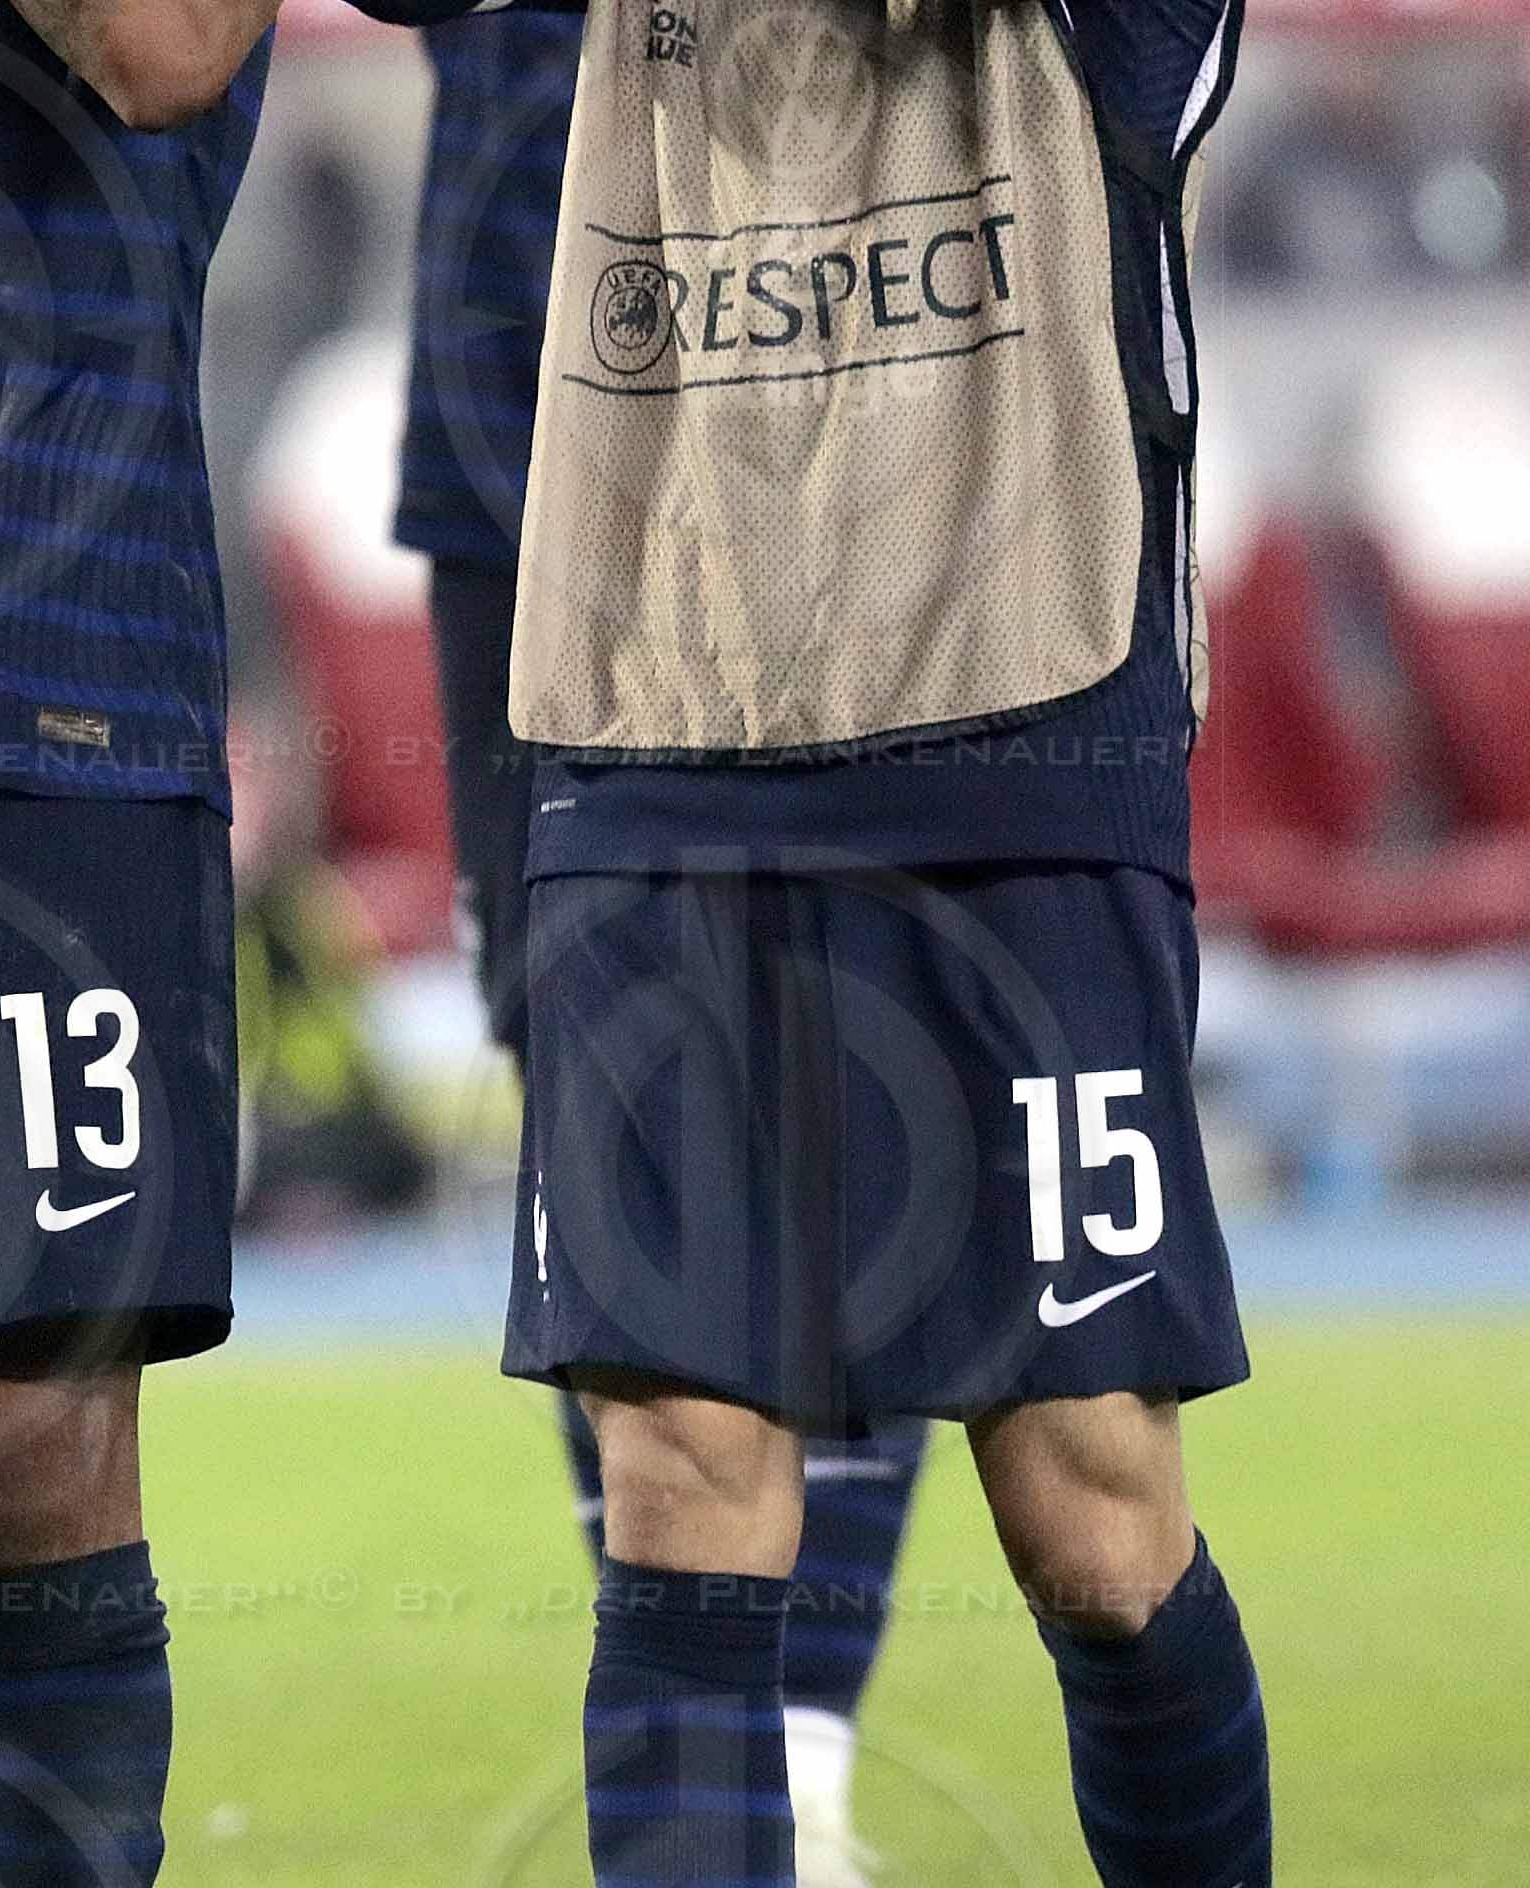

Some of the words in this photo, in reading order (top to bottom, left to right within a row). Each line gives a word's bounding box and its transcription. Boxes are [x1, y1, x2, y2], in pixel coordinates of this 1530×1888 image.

[665, 212, 1016, 354] RESPECT
[0, 987, 141, 1170] 13
[1011, 1068, 1164, 1262] 15
